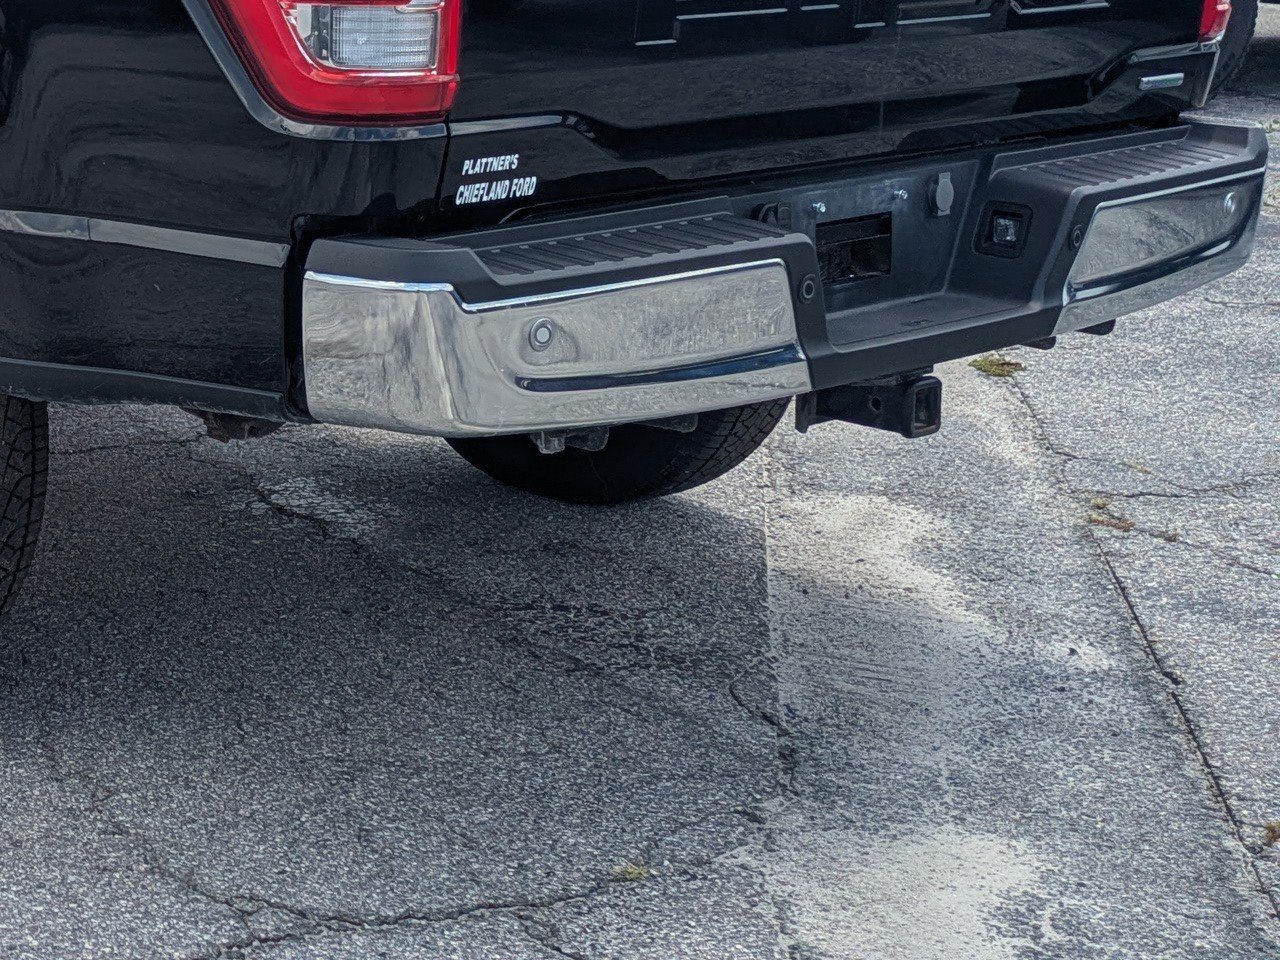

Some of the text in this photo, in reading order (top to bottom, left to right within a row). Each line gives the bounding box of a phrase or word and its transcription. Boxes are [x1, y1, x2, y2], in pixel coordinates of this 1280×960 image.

[461, 153, 520, 176] PLATTNER'S
[455, 176, 537, 206] CHIEFLAND FORD
